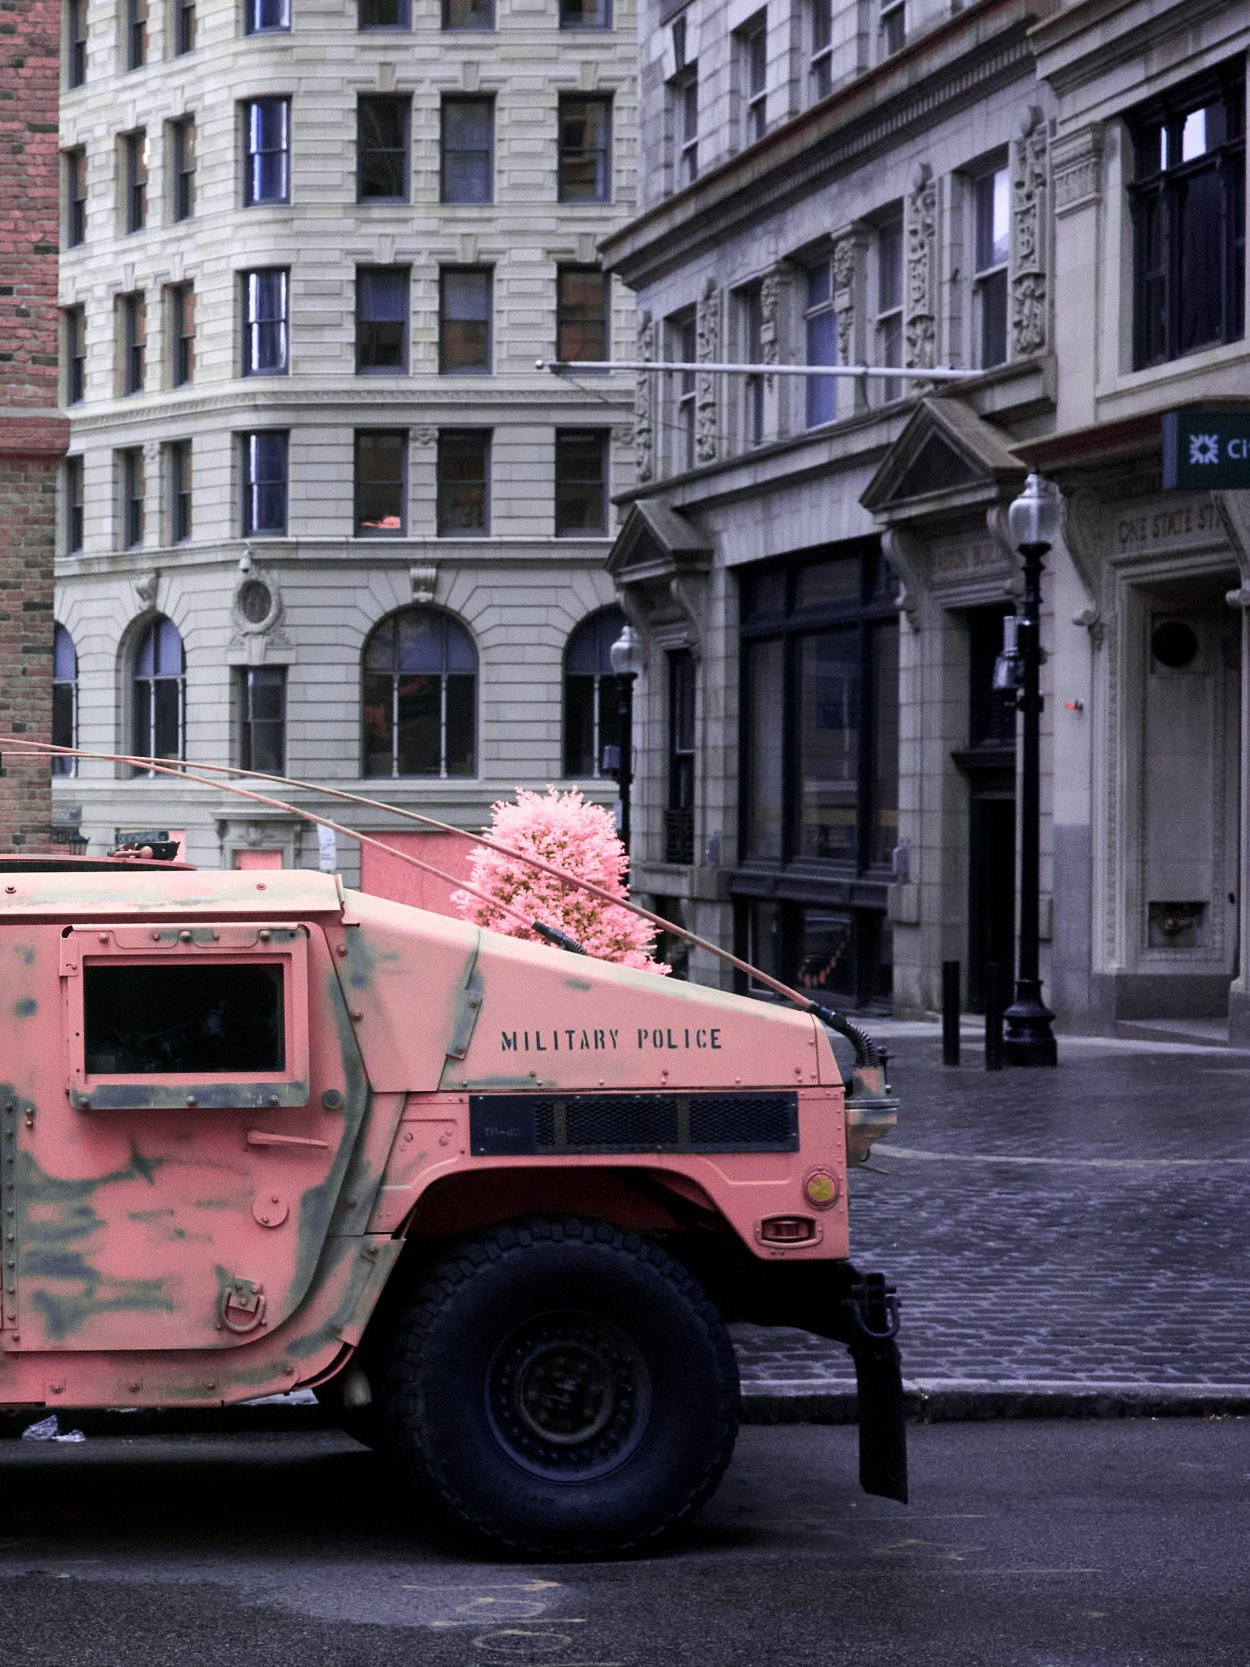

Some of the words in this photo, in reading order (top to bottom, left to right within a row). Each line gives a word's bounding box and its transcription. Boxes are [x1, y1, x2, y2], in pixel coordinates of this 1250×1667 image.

[1118, 517, 1147, 544] ONE
[1152, 508, 1192, 538] STATE
[501, 1028, 619, 1052] MILITARY
[637, 1028, 723, 1050] POLICE
